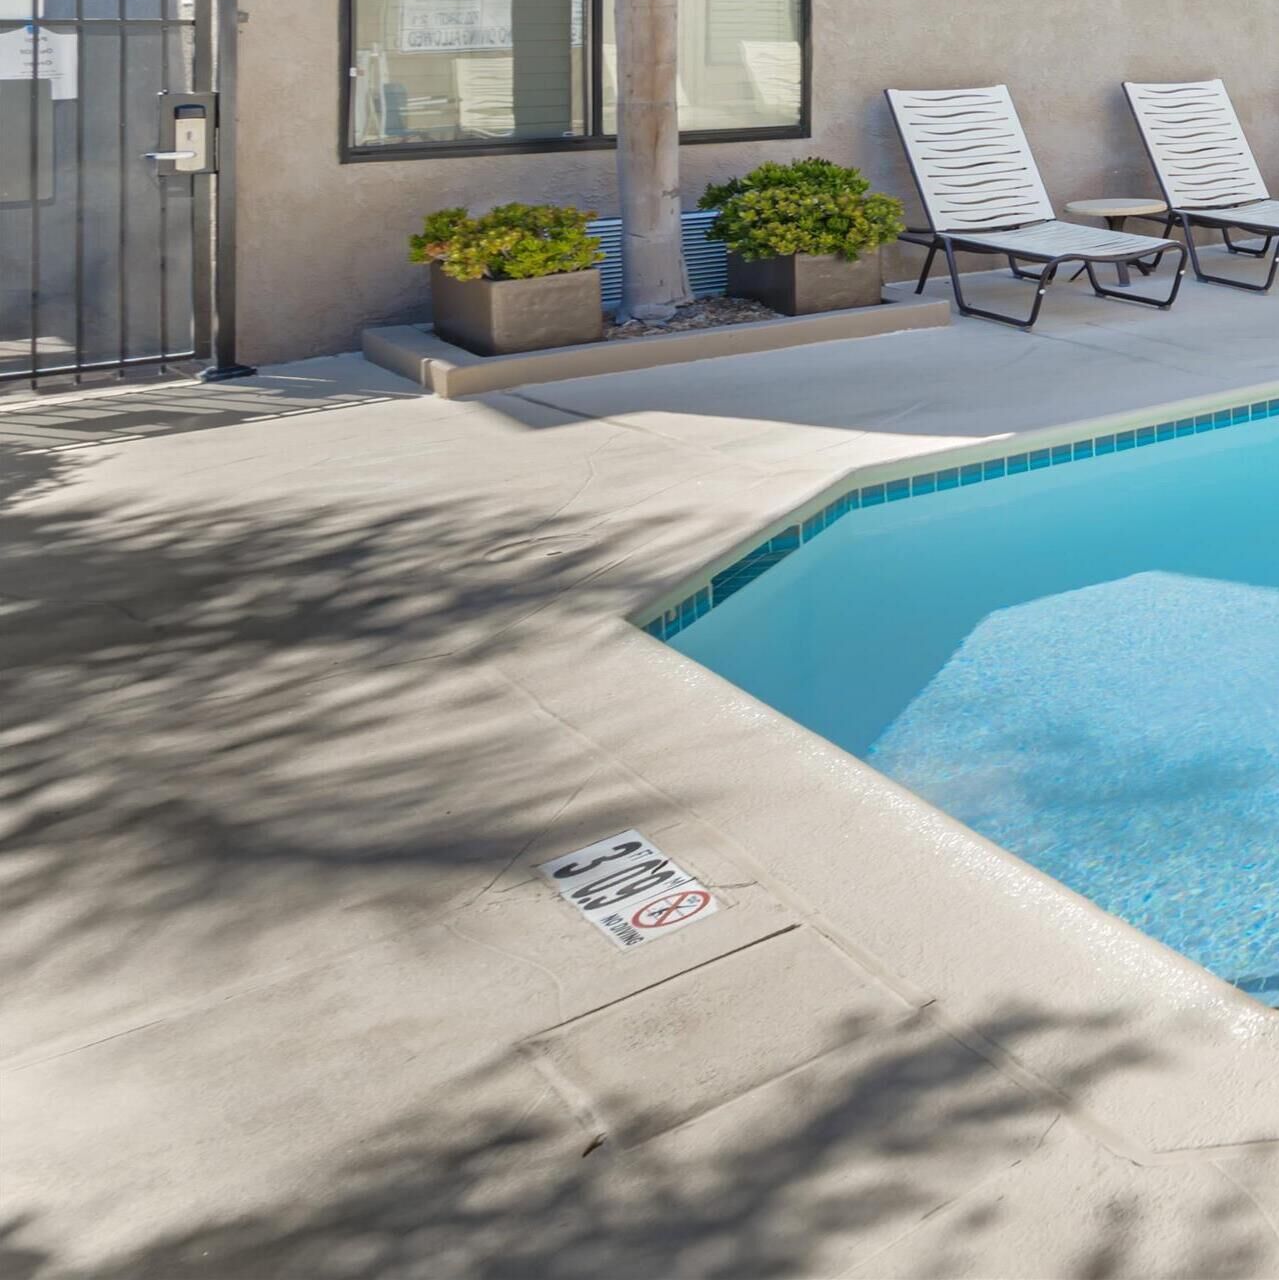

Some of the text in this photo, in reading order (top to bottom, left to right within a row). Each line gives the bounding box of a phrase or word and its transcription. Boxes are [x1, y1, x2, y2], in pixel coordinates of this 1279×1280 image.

[553, 841, 642, 878] 3
[600, 913, 644, 945] NO DIVING
